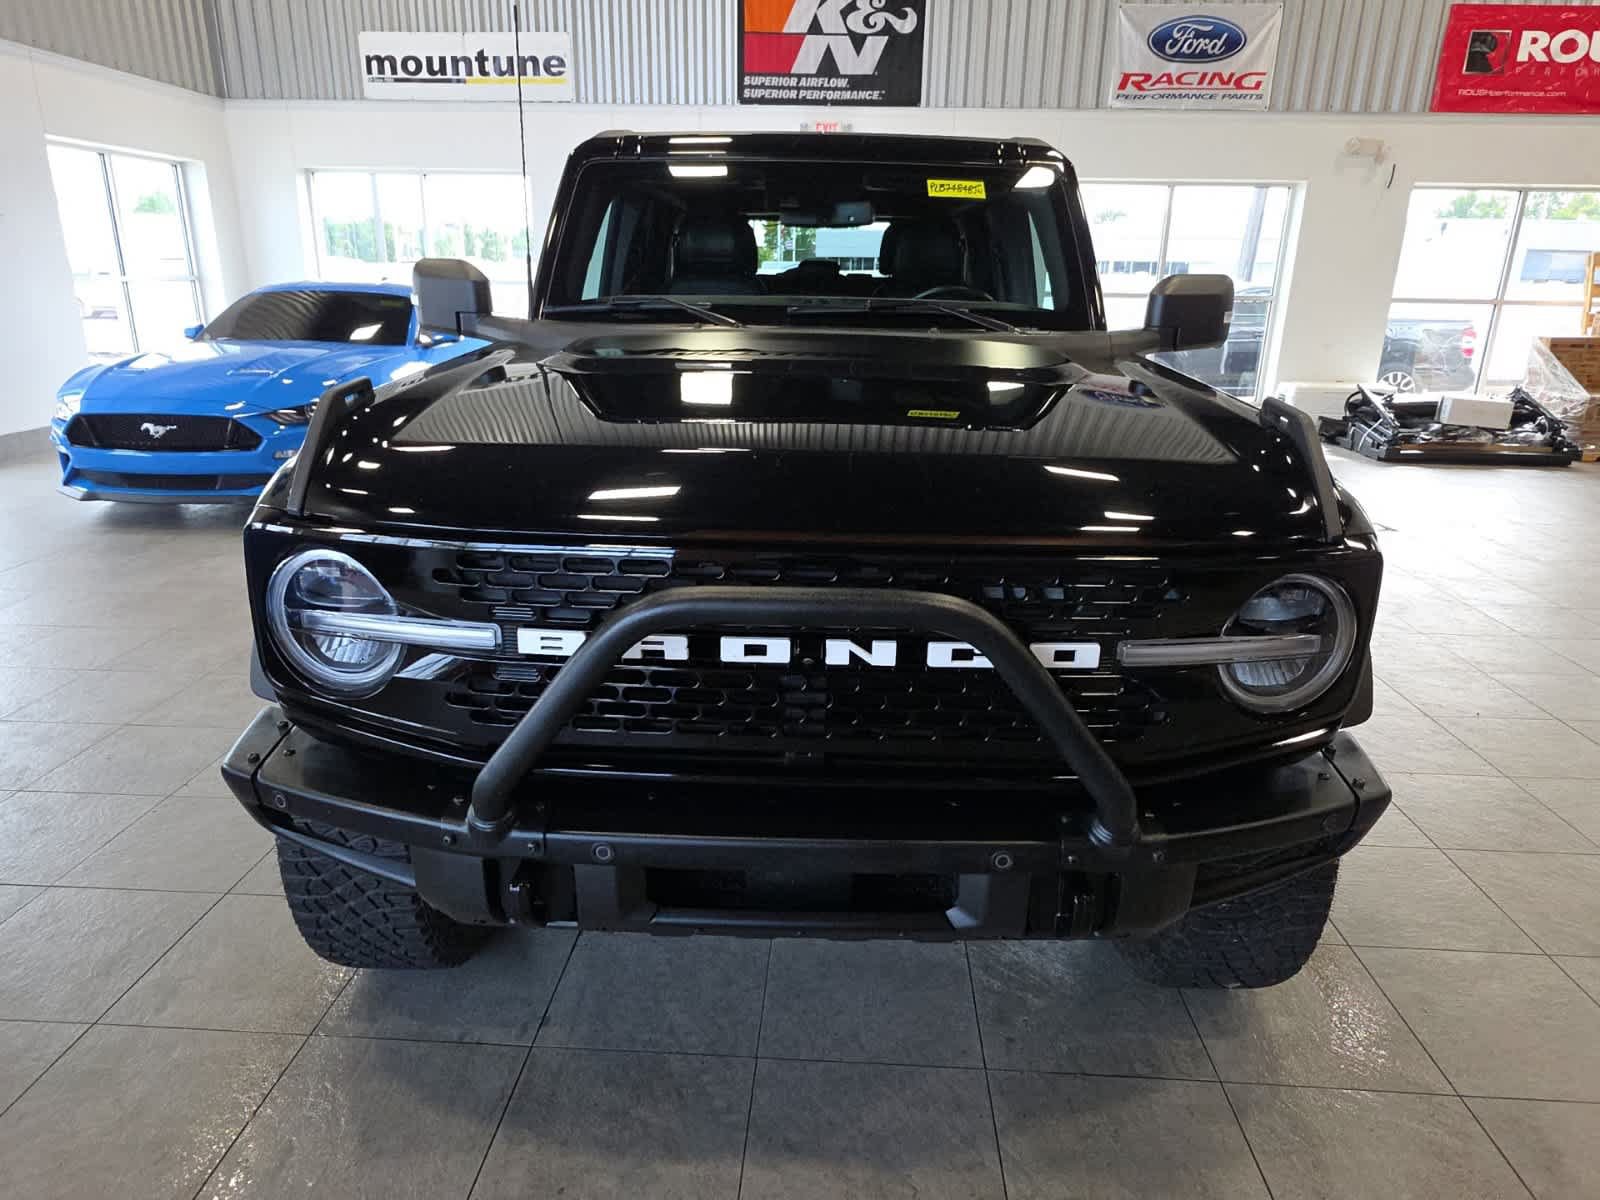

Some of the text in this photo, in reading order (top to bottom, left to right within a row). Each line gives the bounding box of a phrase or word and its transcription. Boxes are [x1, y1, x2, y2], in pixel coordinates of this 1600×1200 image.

[1165, 23, 1229, 55] Ford
[365, 48, 567, 77] mountune
[743, 76, 801, 87] SUPERIOR
[1117, 71, 1268, 92] RACING
[743, 88, 800, 99] SUPERIOR
[1115, 93, 1264, 101] PERFORMANCE PARTS
[815, 121, 838, 132] EXIT
[517, 627, 1101, 669] BRONCO
